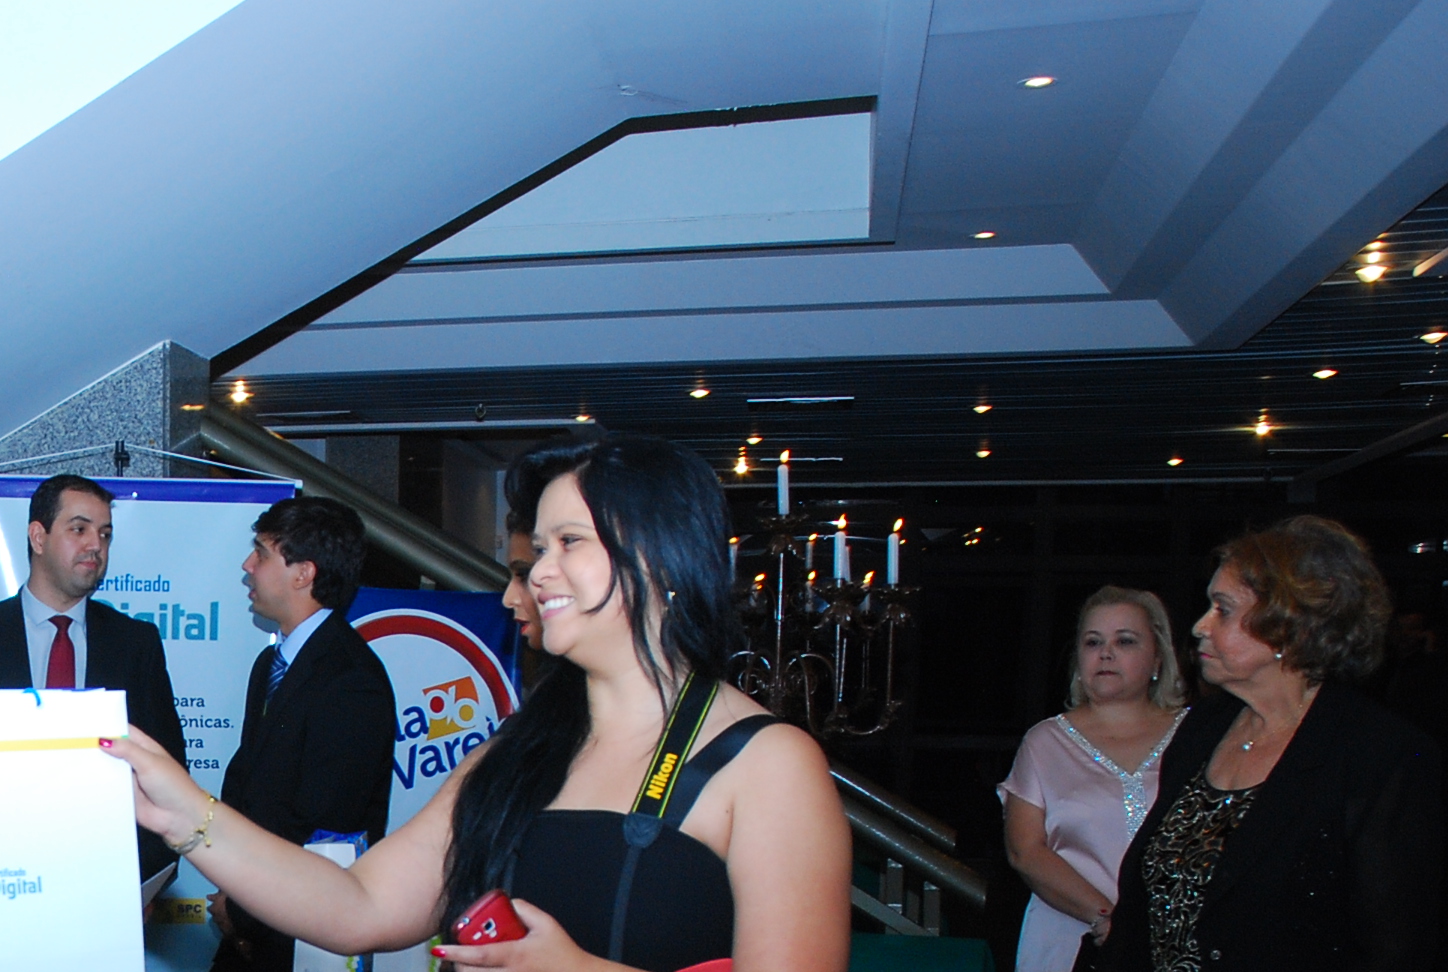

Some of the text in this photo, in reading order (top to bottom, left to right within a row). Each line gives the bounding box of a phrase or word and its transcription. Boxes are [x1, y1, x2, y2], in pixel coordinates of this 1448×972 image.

[97, 573, 170, 592] ertificado
[92, 599, 219, 641] ital
[185, 738, 204, 749] ra
[645, 752, 679, 800] Nikon
[177, 903, 202, 914] SPC
